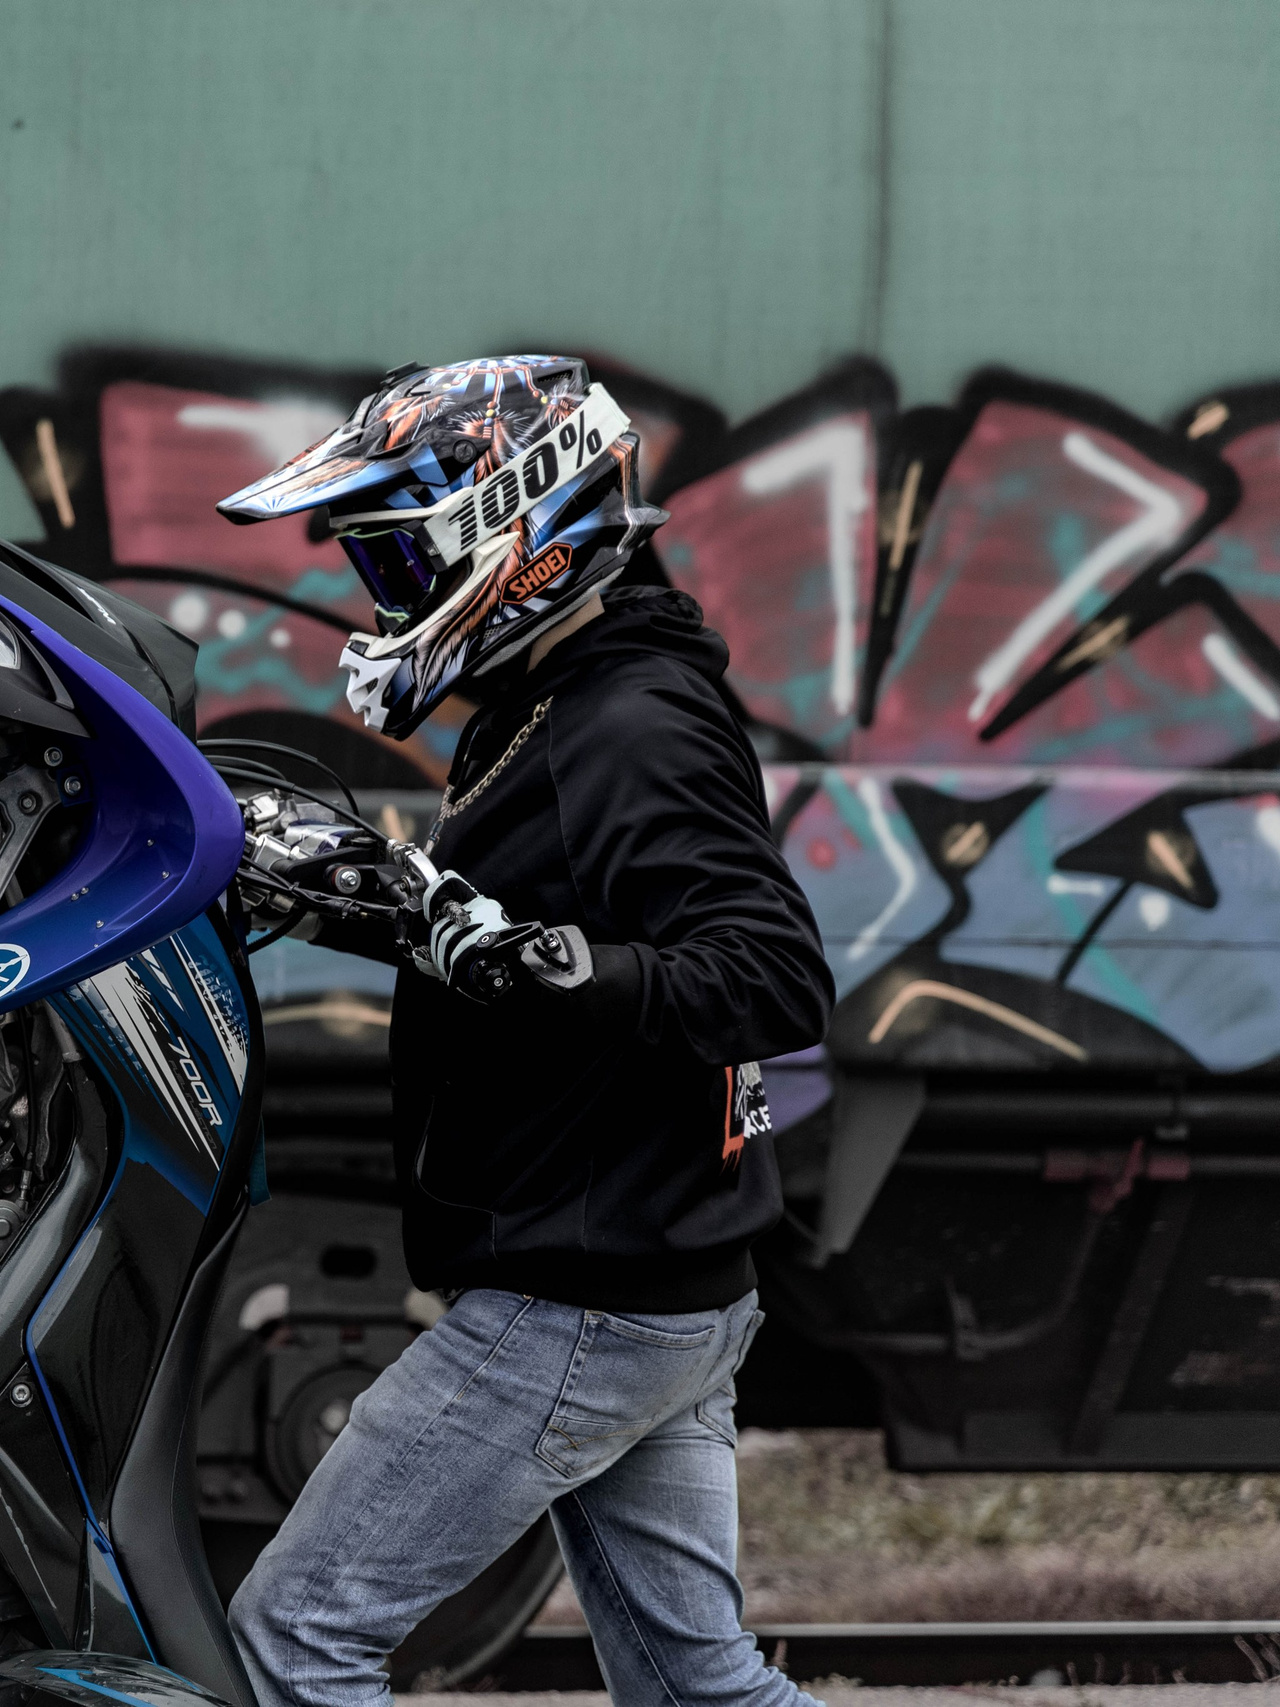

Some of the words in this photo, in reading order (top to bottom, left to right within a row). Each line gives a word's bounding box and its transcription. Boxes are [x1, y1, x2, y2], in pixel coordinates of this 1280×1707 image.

[448, 410, 603, 552] 100%
[509, 549, 567, 599] SHOEI
[168, 1036, 223, 1126] 700R
